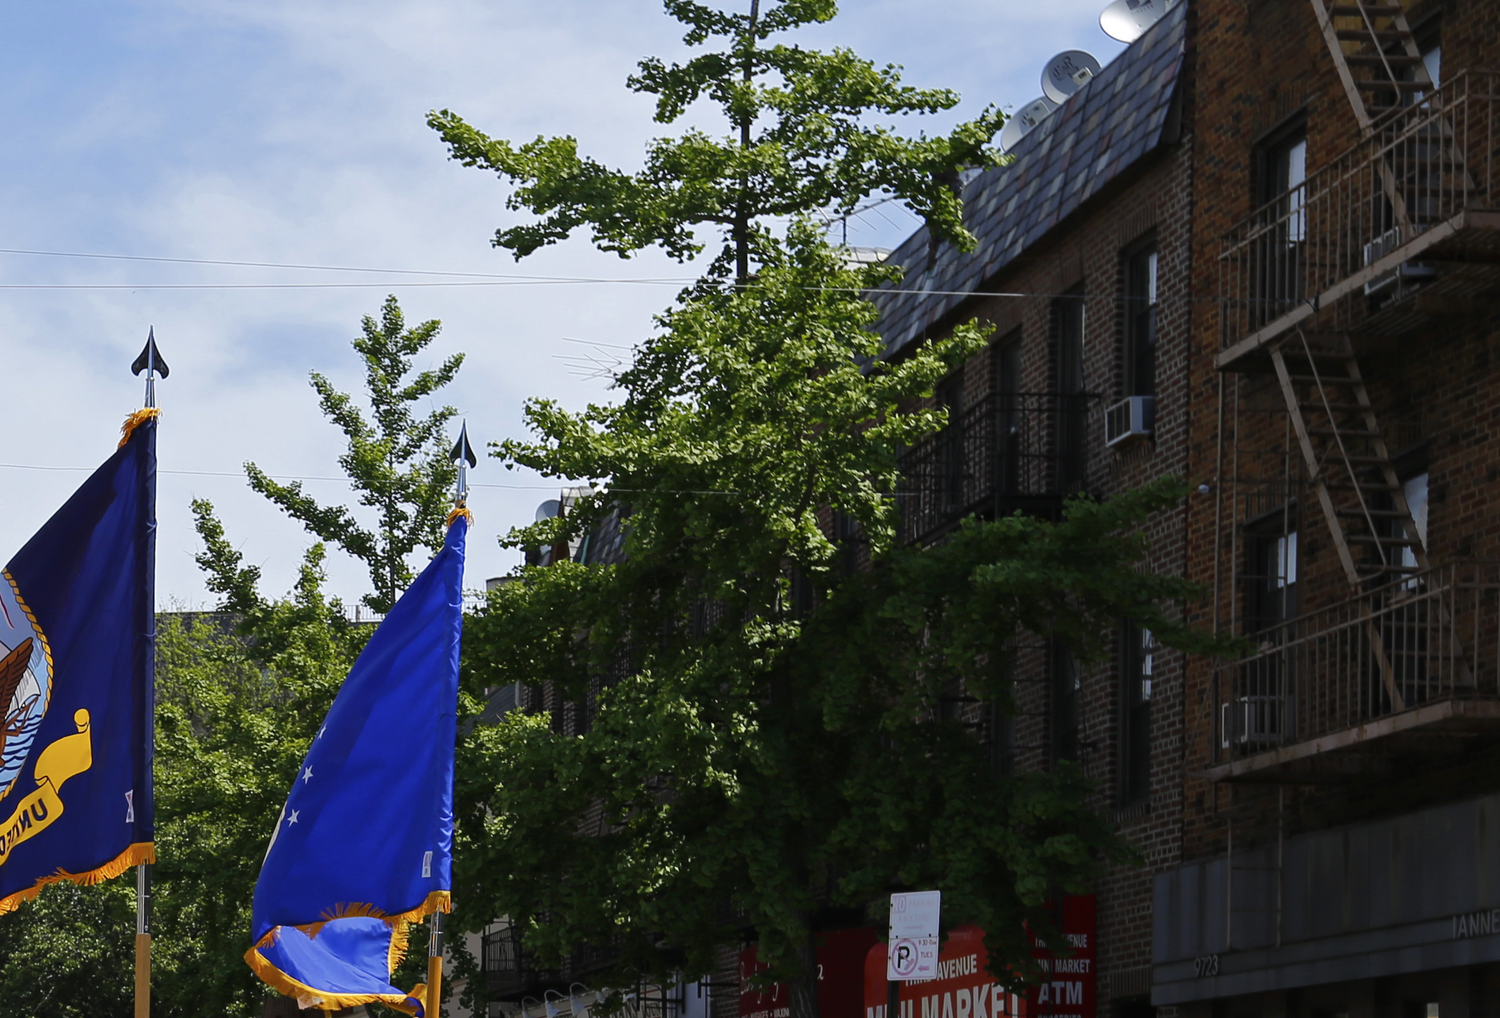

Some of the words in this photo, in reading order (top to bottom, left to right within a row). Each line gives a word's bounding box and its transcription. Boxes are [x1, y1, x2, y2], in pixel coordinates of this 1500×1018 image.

[937, 954, 978, 981] AVENUE
[1054, 958, 1091, 973] MARKET
[1193, 954, 1219, 978] 9723
[1037, 980, 1083, 1005] ATM
